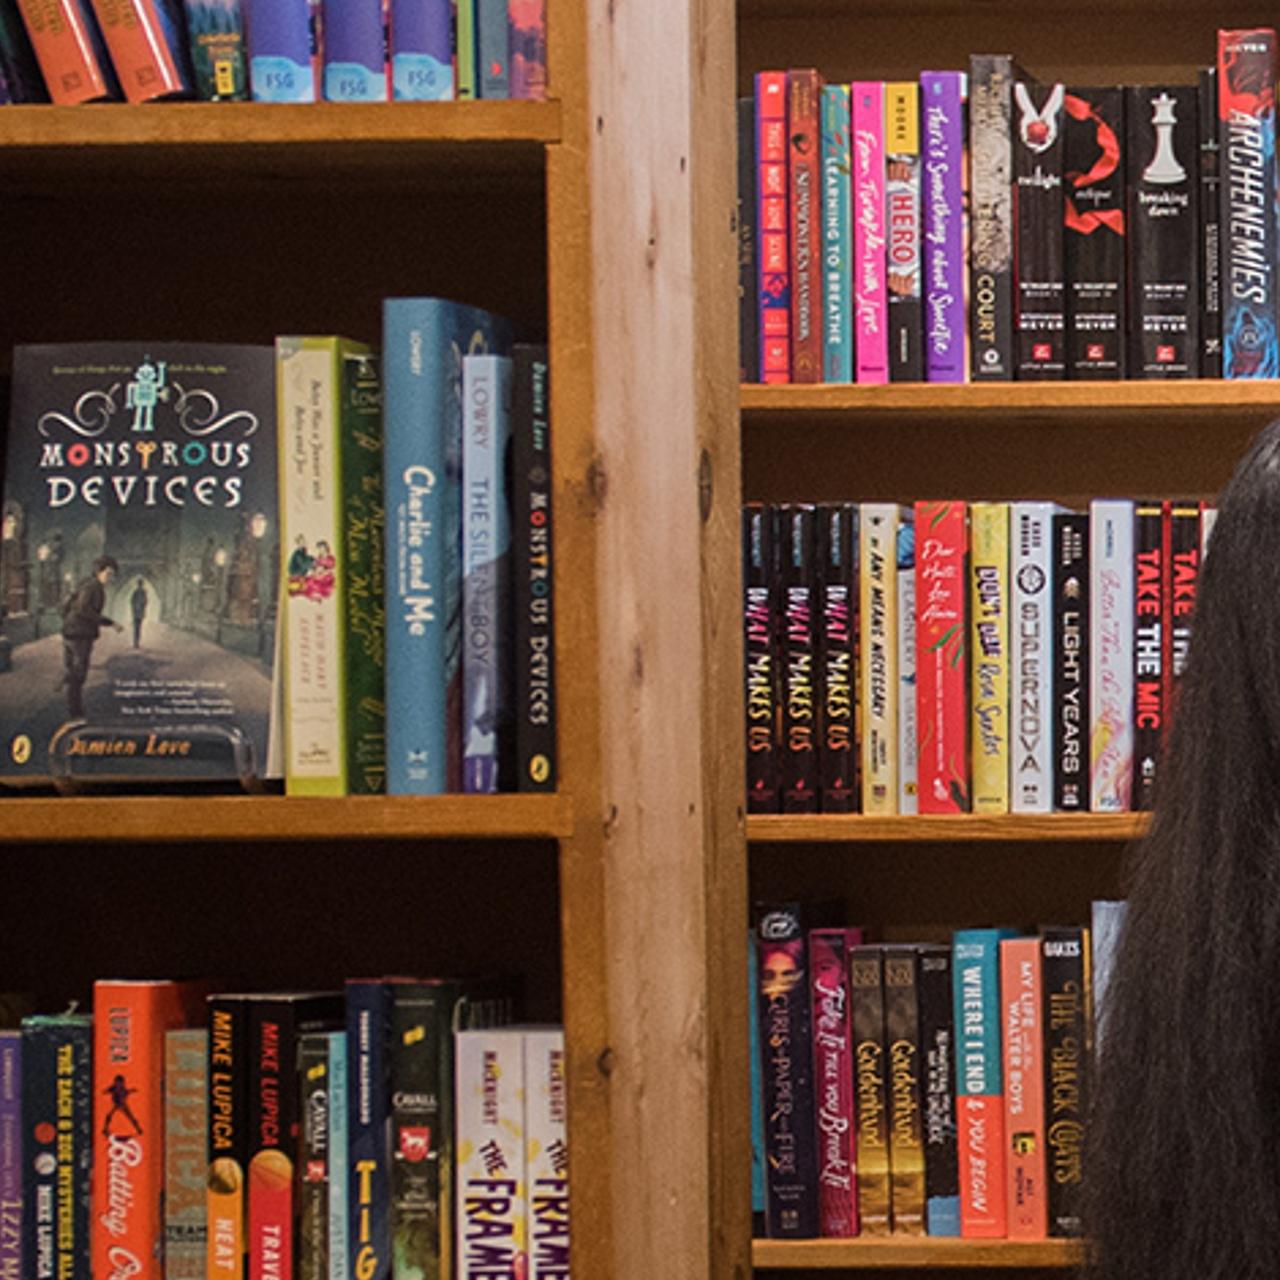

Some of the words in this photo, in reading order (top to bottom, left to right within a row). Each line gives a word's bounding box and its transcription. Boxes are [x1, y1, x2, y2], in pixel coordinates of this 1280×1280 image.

[264, 71, 294, 89] FSG
[827, 158, 840, 240] LEARNING
[1230, 111, 1267, 304] ARCHENEMIES
[827, 247, 840, 266] TO
[892, 195, 915, 262] HERO
[827, 274, 841, 344] BREATHE
[40, 440, 251, 470] MONSTROUS
[46, 475, 243, 508] DEVICES
[402, 464, 435, 543] Charlie
[407, 549, 433, 579] and
[529, 492, 549, 628] MONSTROUS
[1135, 549, 1160, 616] TAKE
[405, 596, 435, 637] Me
[1063, 610, 1080, 683] LIGHT
[1137, 623, 1160, 675] THE
[529, 635, 549, 726] DEVICES
[1020, 603, 1040, 772] SUPERNOVA
[1136, 683, 1160, 729] MIC
[1063, 687, 1080, 774] YEARS
[1021, 961, 1033, 987] MY
[213, 1011, 233, 1059] MIKE
[1009, 1001, 1023, 1065] WALTER
[1021, 991, 1034, 1026] LIFE
[212, 1067, 233, 1150] LUPICA
[1009, 1071, 1023, 1114] BOYS
[100, 1133, 143, 1237] Batting
[479, 1140, 507, 1177] THE
[216, 1220, 235, 1269] HEAT
